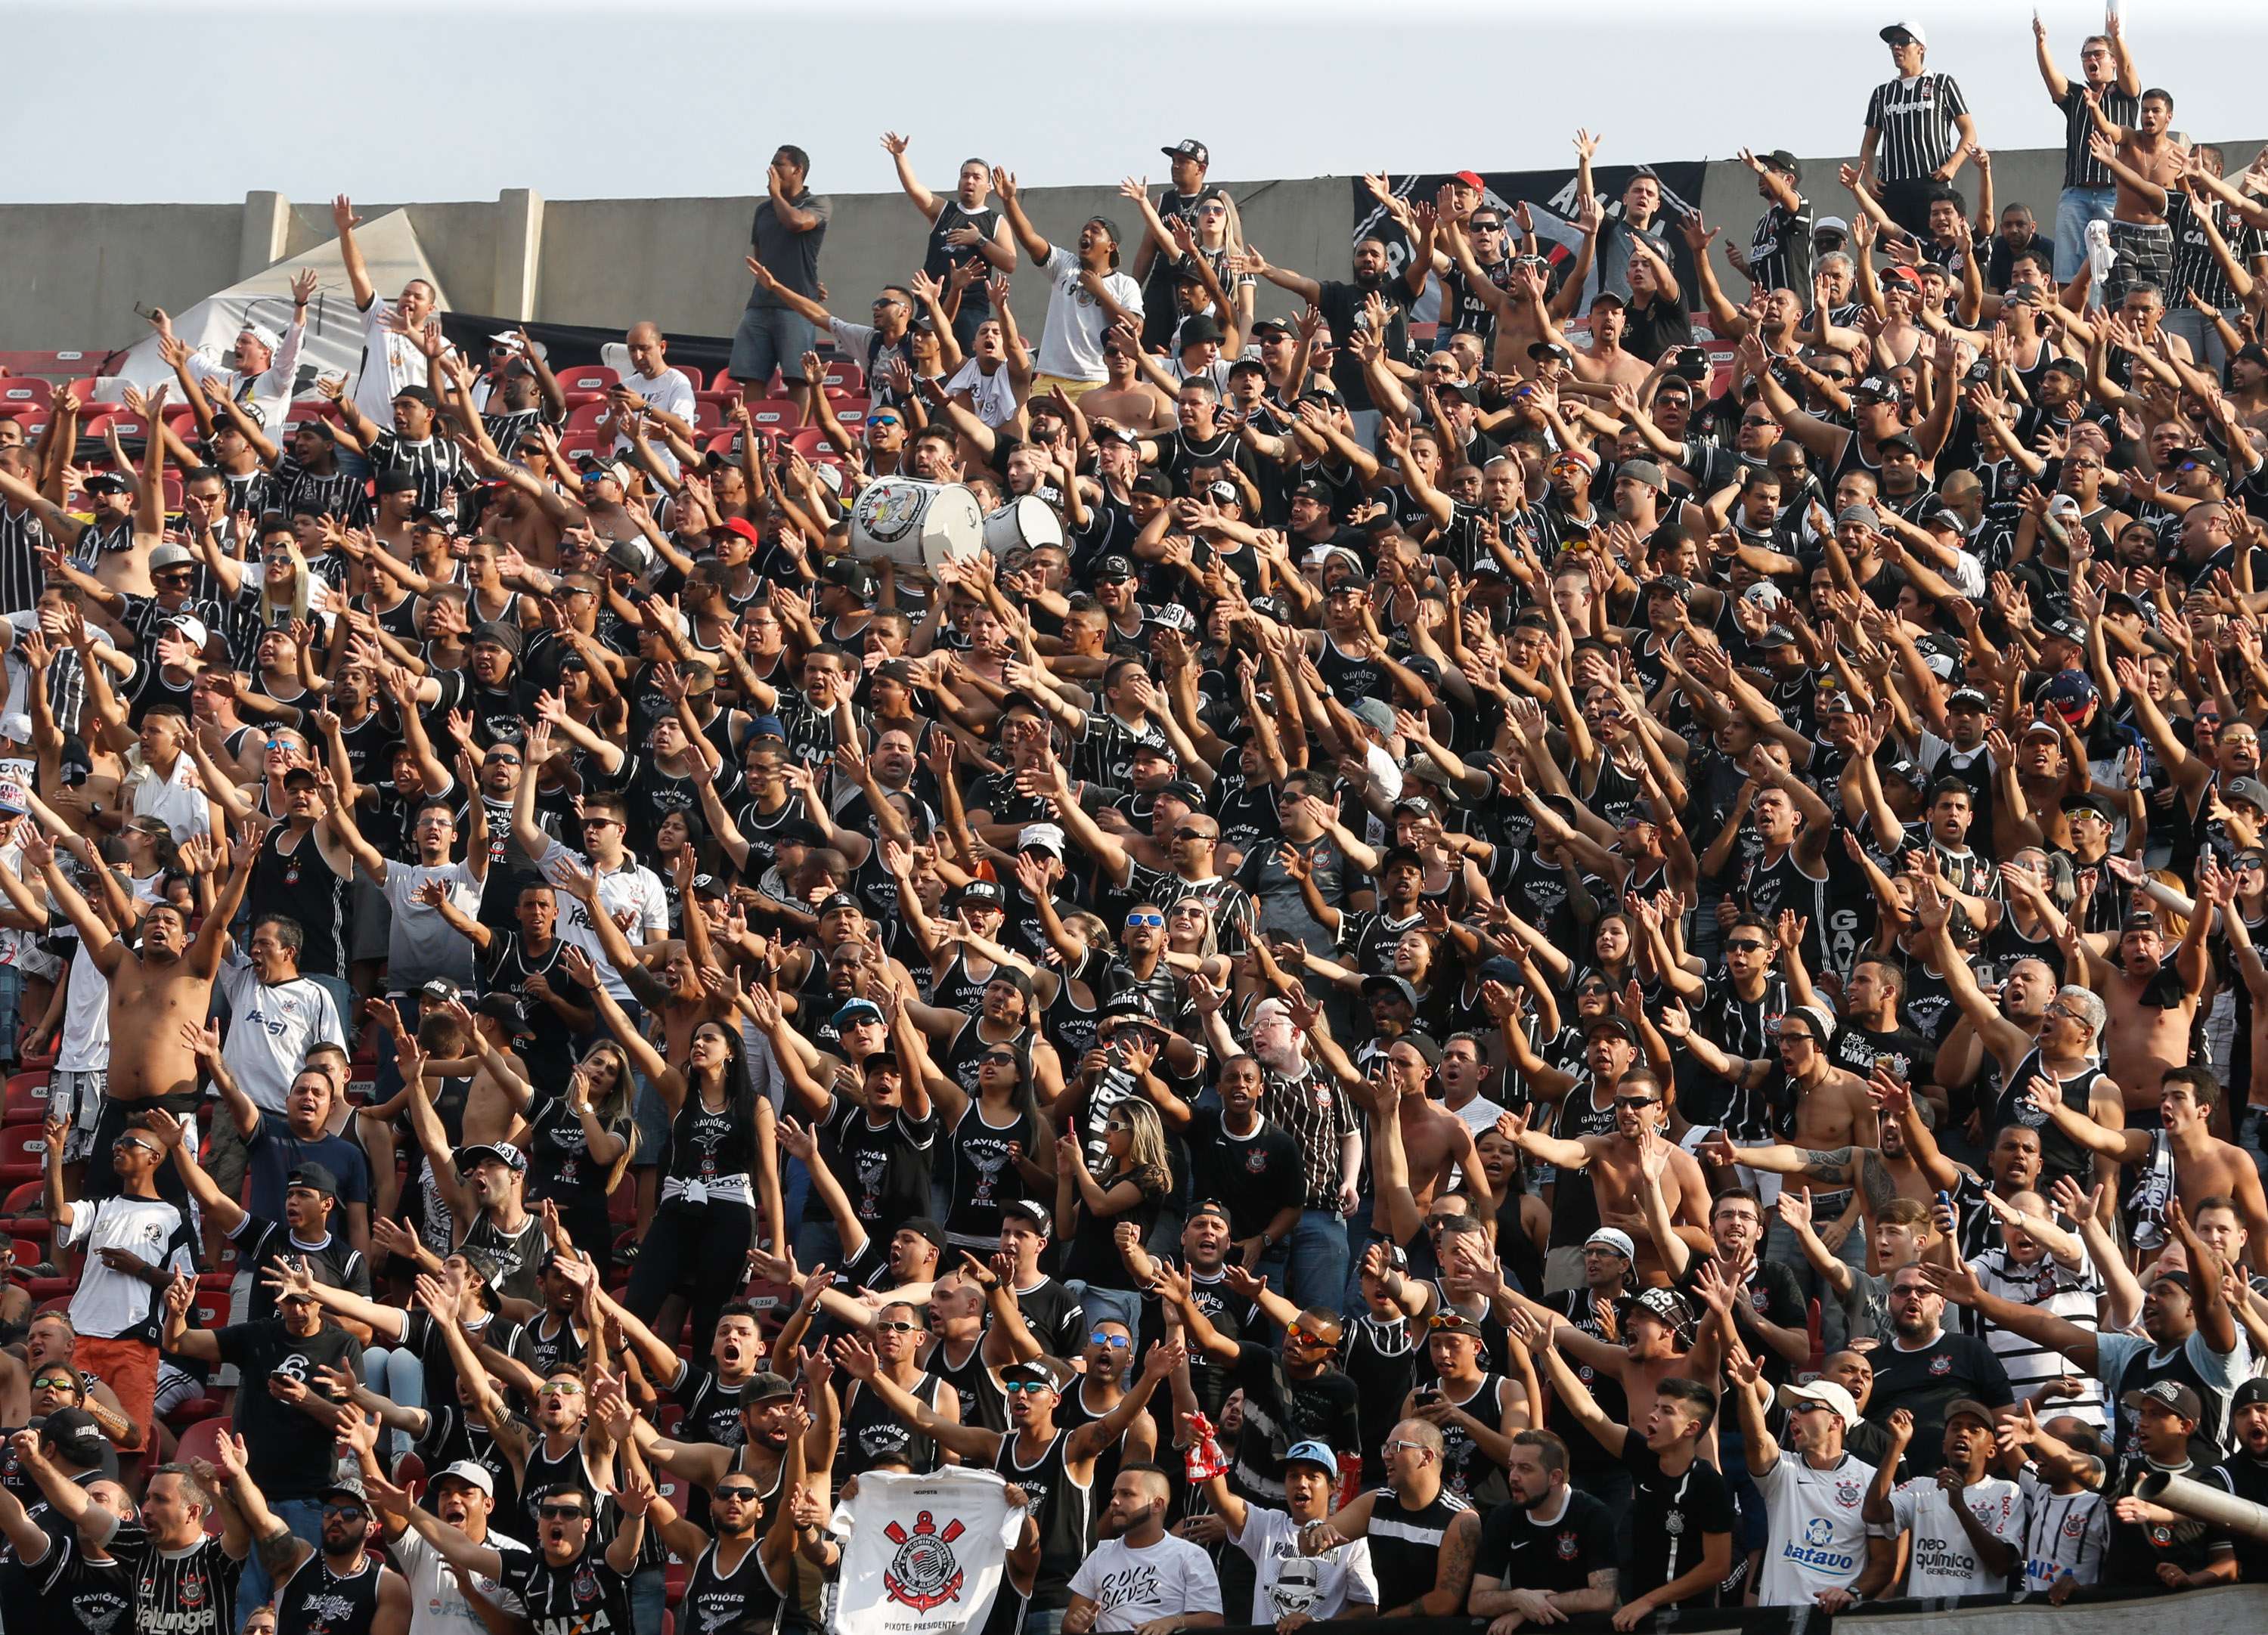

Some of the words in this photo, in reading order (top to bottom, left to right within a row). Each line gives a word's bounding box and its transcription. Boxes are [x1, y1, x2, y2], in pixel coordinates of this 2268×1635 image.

[1883, 100, 1935, 116] Kalunga
[2183, 231, 2209, 246] CAI
[1464, 298, 1484, 311] CAI
[1473, 558, 1501, 573] GAVIÕES
[1343, 670, 1377, 682] GAVIÕES
[652, 790, 692, 804] GAVIÕES
[1605, 801, 1630, 811] GAVI
[751, 842, 774, 853] VIÕES
[490, 853, 507, 863] IEL
[1525, 881, 1567, 895] GAVIÕES
[1375, 942, 1399, 950] GAVI
[956, 986, 989, 997] GAVIÕE
[1907, 996, 1950, 1009] GAVIÕES
[246, 1010, 287, 1036] PESI
[513, 1038, 527, 1048] IEL
[1089, 1066, 1136, 1134] MARIA
[551, 1128, 585, 1137] GAVIÕ
[554, 1175, 581, 1184] FIEL
[971, 1199, 998, 1207] FIEL
[1189, 1293, 1224, 1311] AVIÕES
[1191, 1355, 1207, 1365] EL
[860, 1424, 911, 1441] GAVIÕES
[2, 1477, 24, 1486] IEL
[1015, 1481, 1049, 1494] VIÕES
[1916, 1538, 1946, 1552] neo
[1783, 1538, 1853, 1570] batavo
[1916, 1552, 1974, 1570] química
[2026, 1559, 2074, 1582] AIXA
[73, 1592, 128, 1608] GAVIÕES
[698, 1593, 745, 1604] GAVIÕES
[1102, 1582, 1162, 1613] SILVER
[533, 1609, 611, 1634] CAIXA
